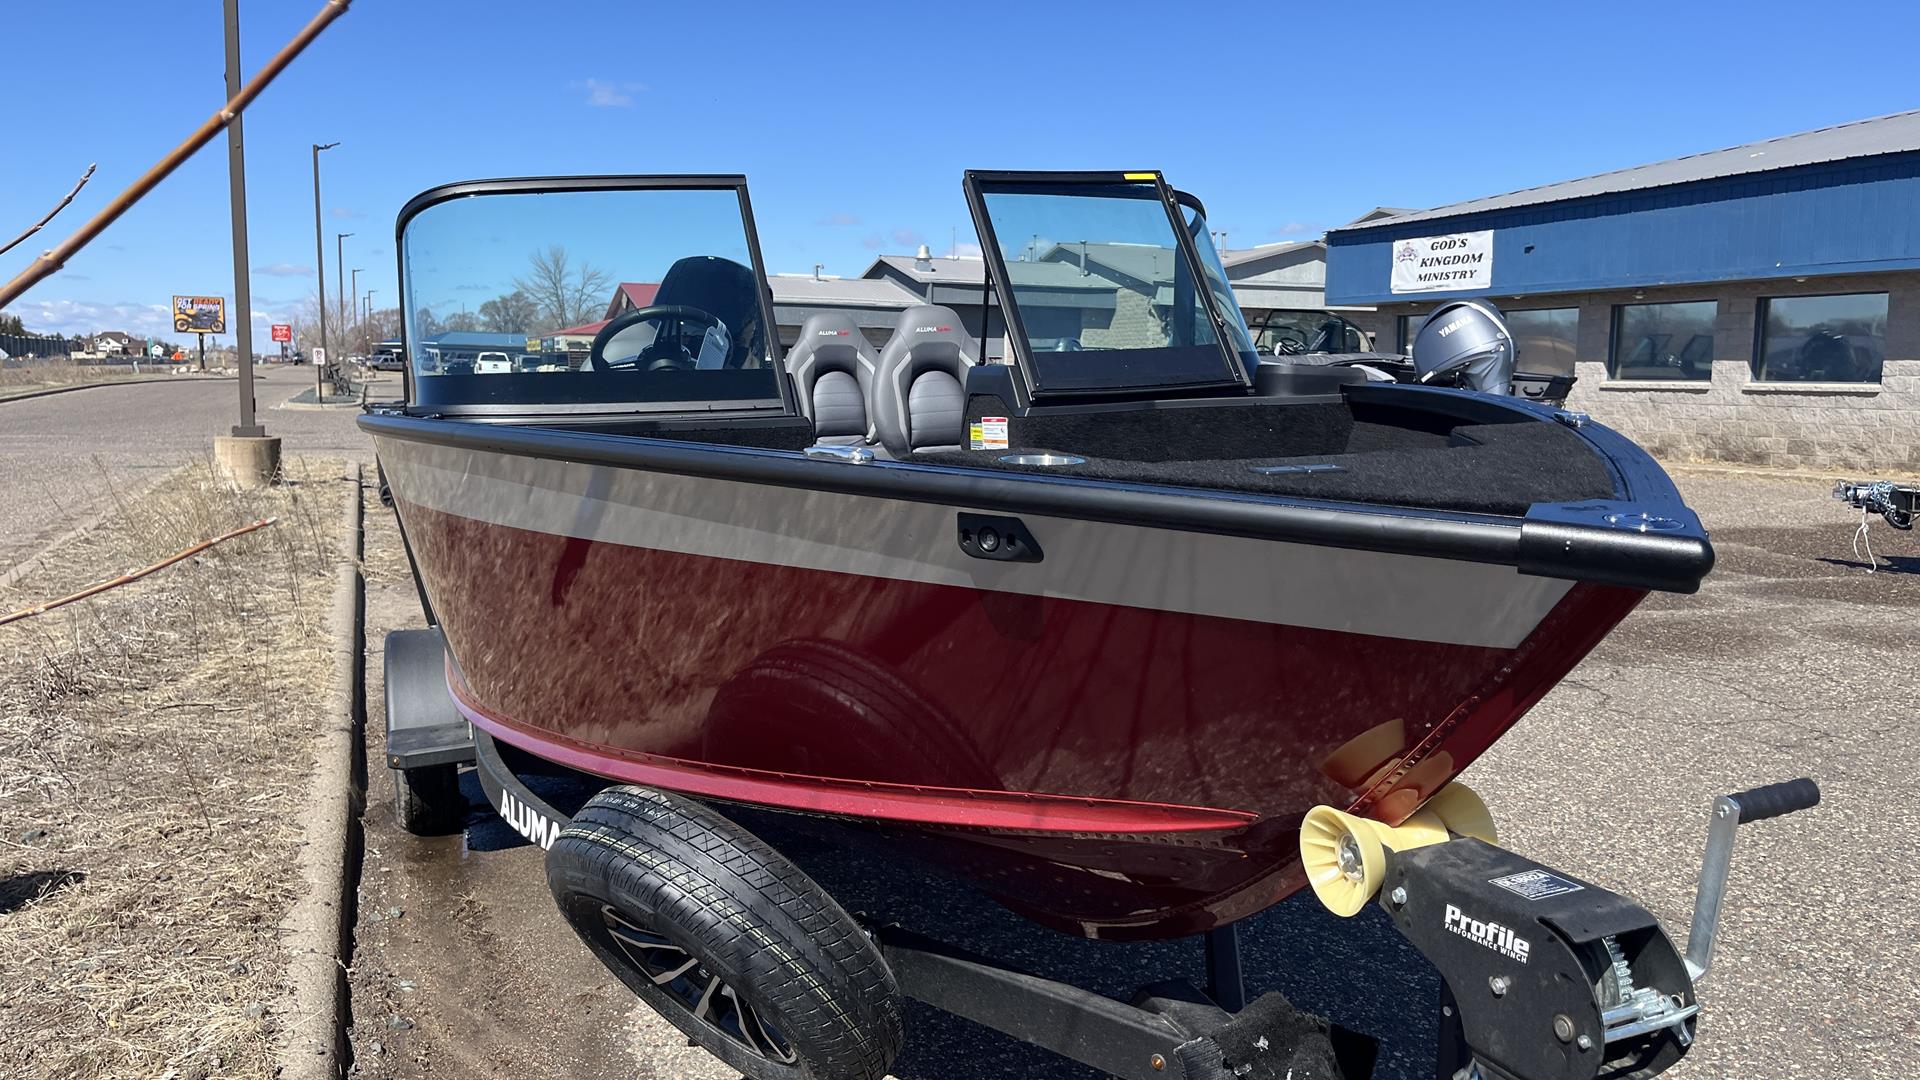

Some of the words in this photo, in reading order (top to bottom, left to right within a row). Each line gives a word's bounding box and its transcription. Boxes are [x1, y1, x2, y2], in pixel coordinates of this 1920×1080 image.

[1430, 238, 1468, 251] GOD'S
[1420, 252, 1484, 268] KINGDOM
[1417, 269, 1478, 282] MINISTRY
[1438, 315, 1474, 338] YAMAHA
[1444, 903, 1530, 957] Profile
[1444, 922, 1498, 951] PERFORMANCE
[1500, 946, 1528, 964] WINCH
